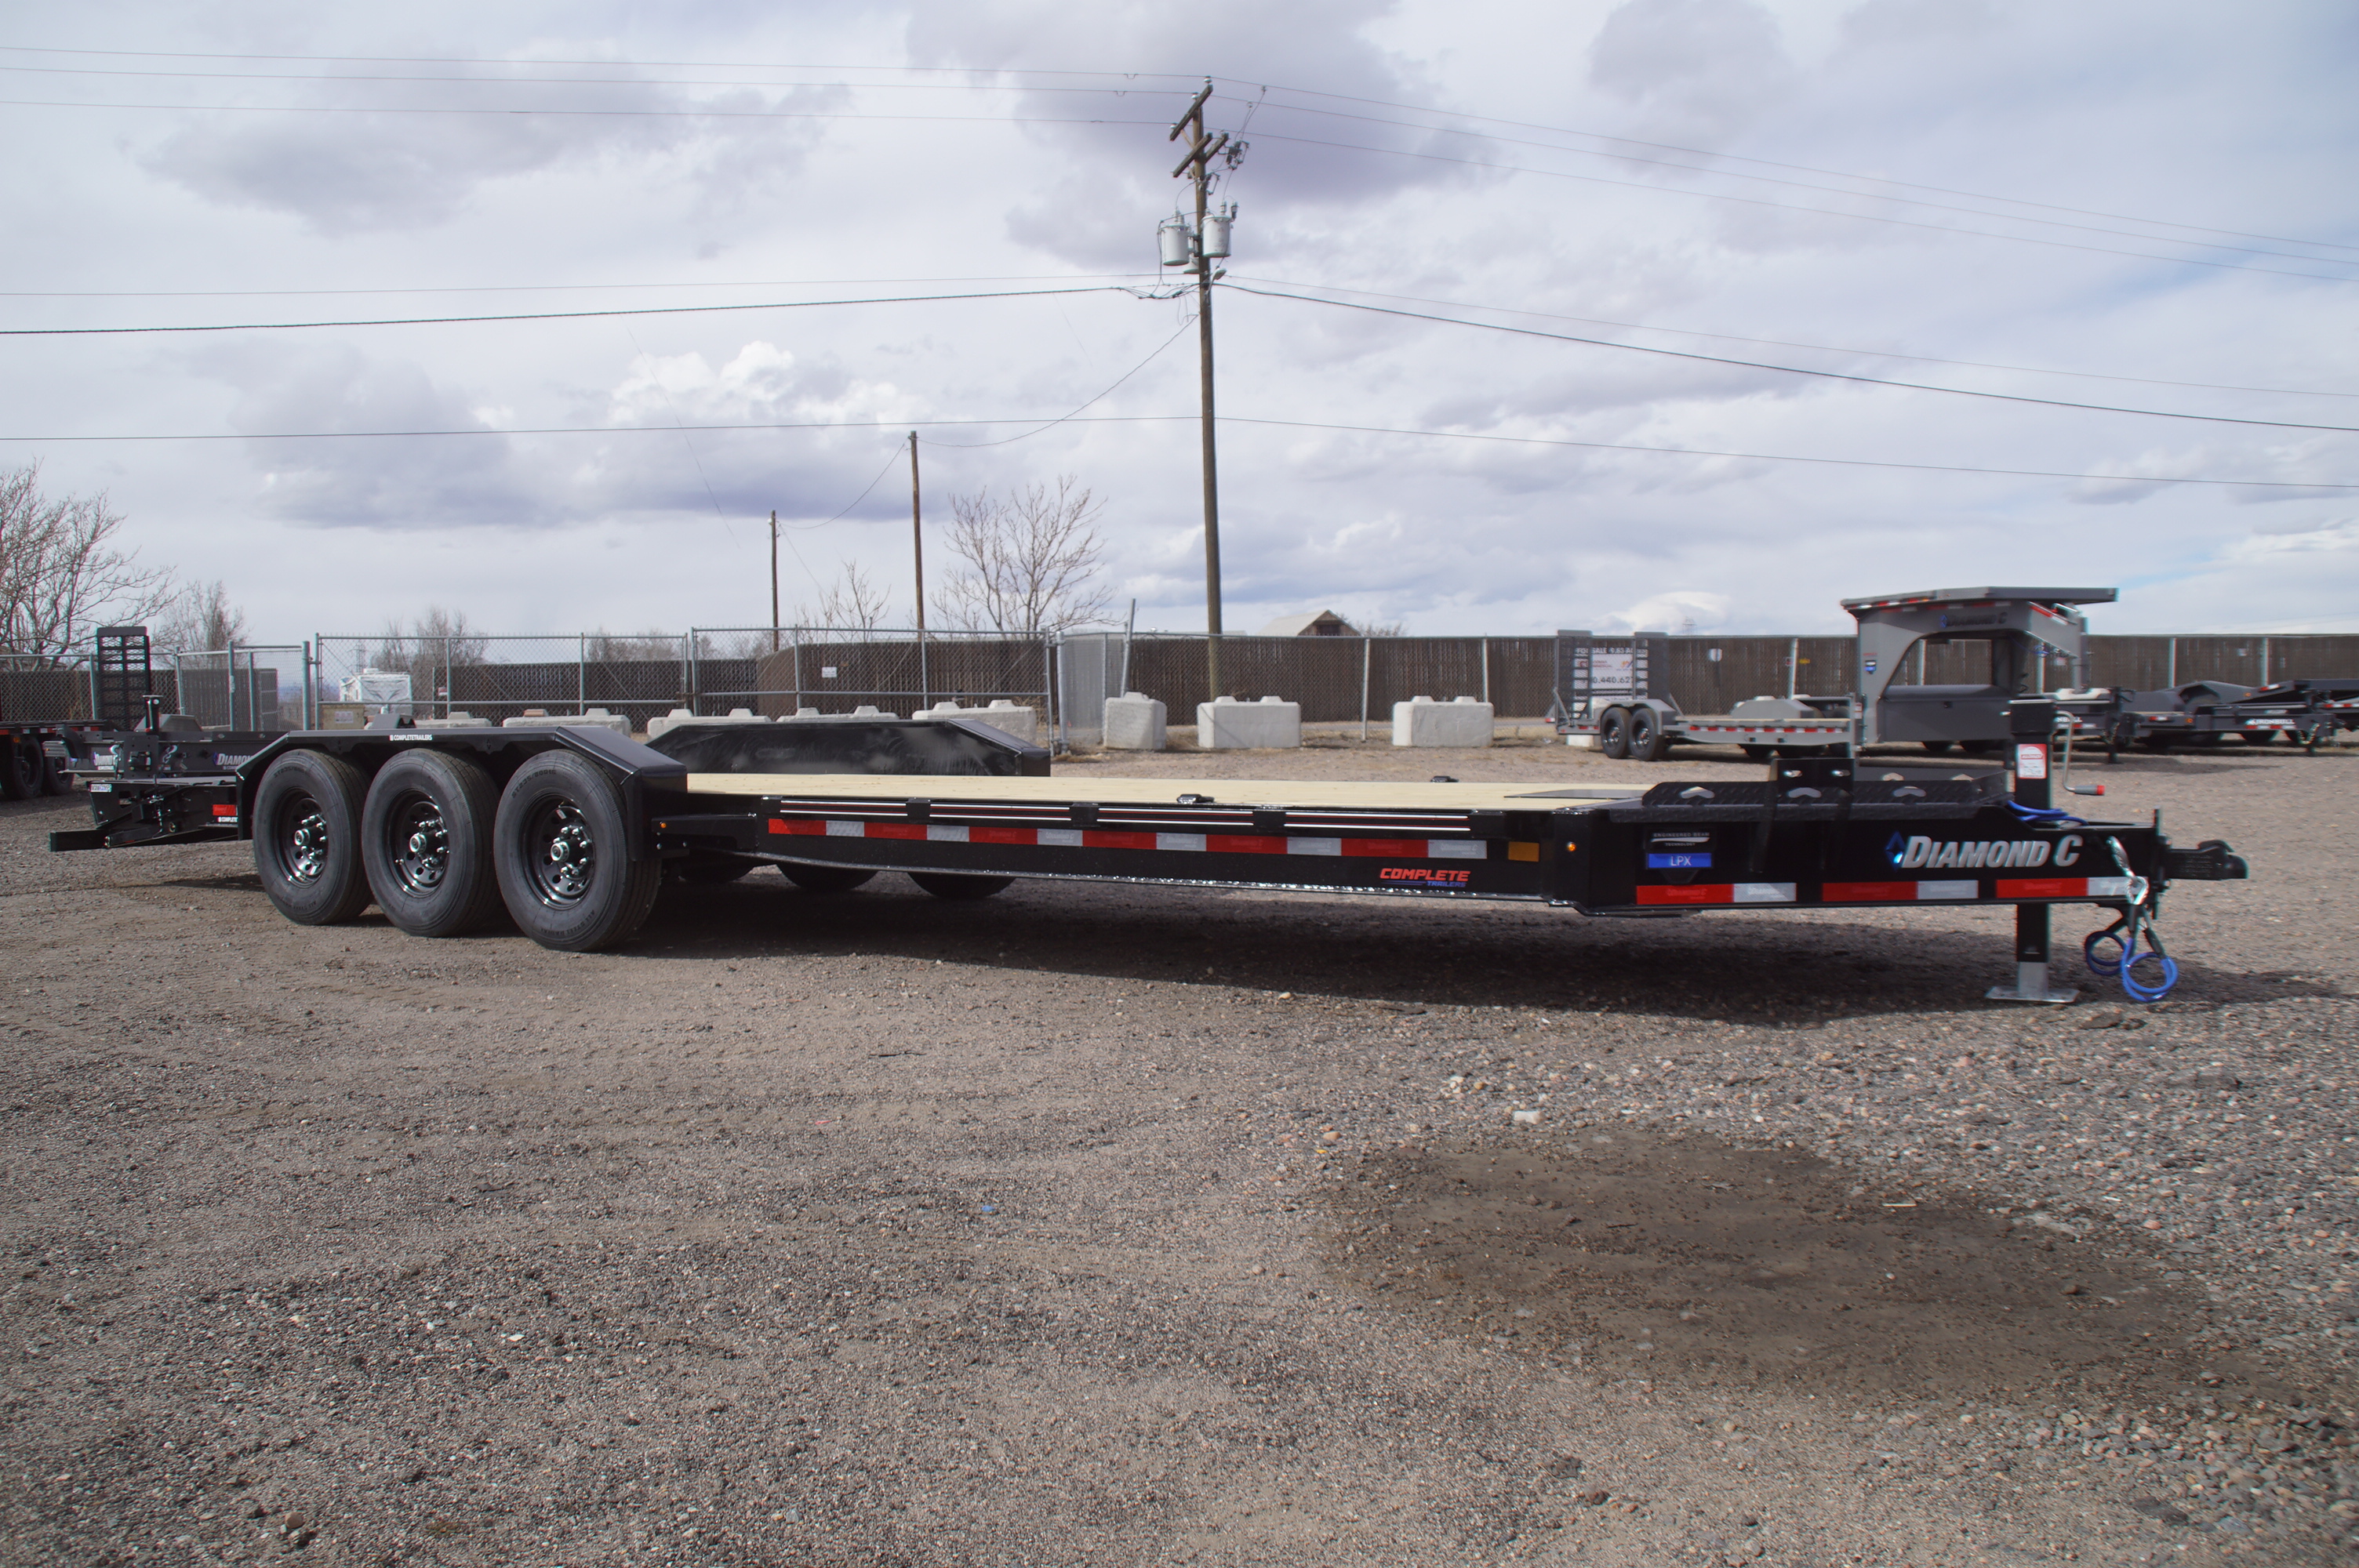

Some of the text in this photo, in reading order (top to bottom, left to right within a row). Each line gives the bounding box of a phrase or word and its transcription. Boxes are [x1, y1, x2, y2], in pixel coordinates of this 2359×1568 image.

[1901, 834, 2084, 869] DIAMOND C
[1670, 855, 1692, 866] LPX
[1379, 868, 1470, 882] COMPLETE
